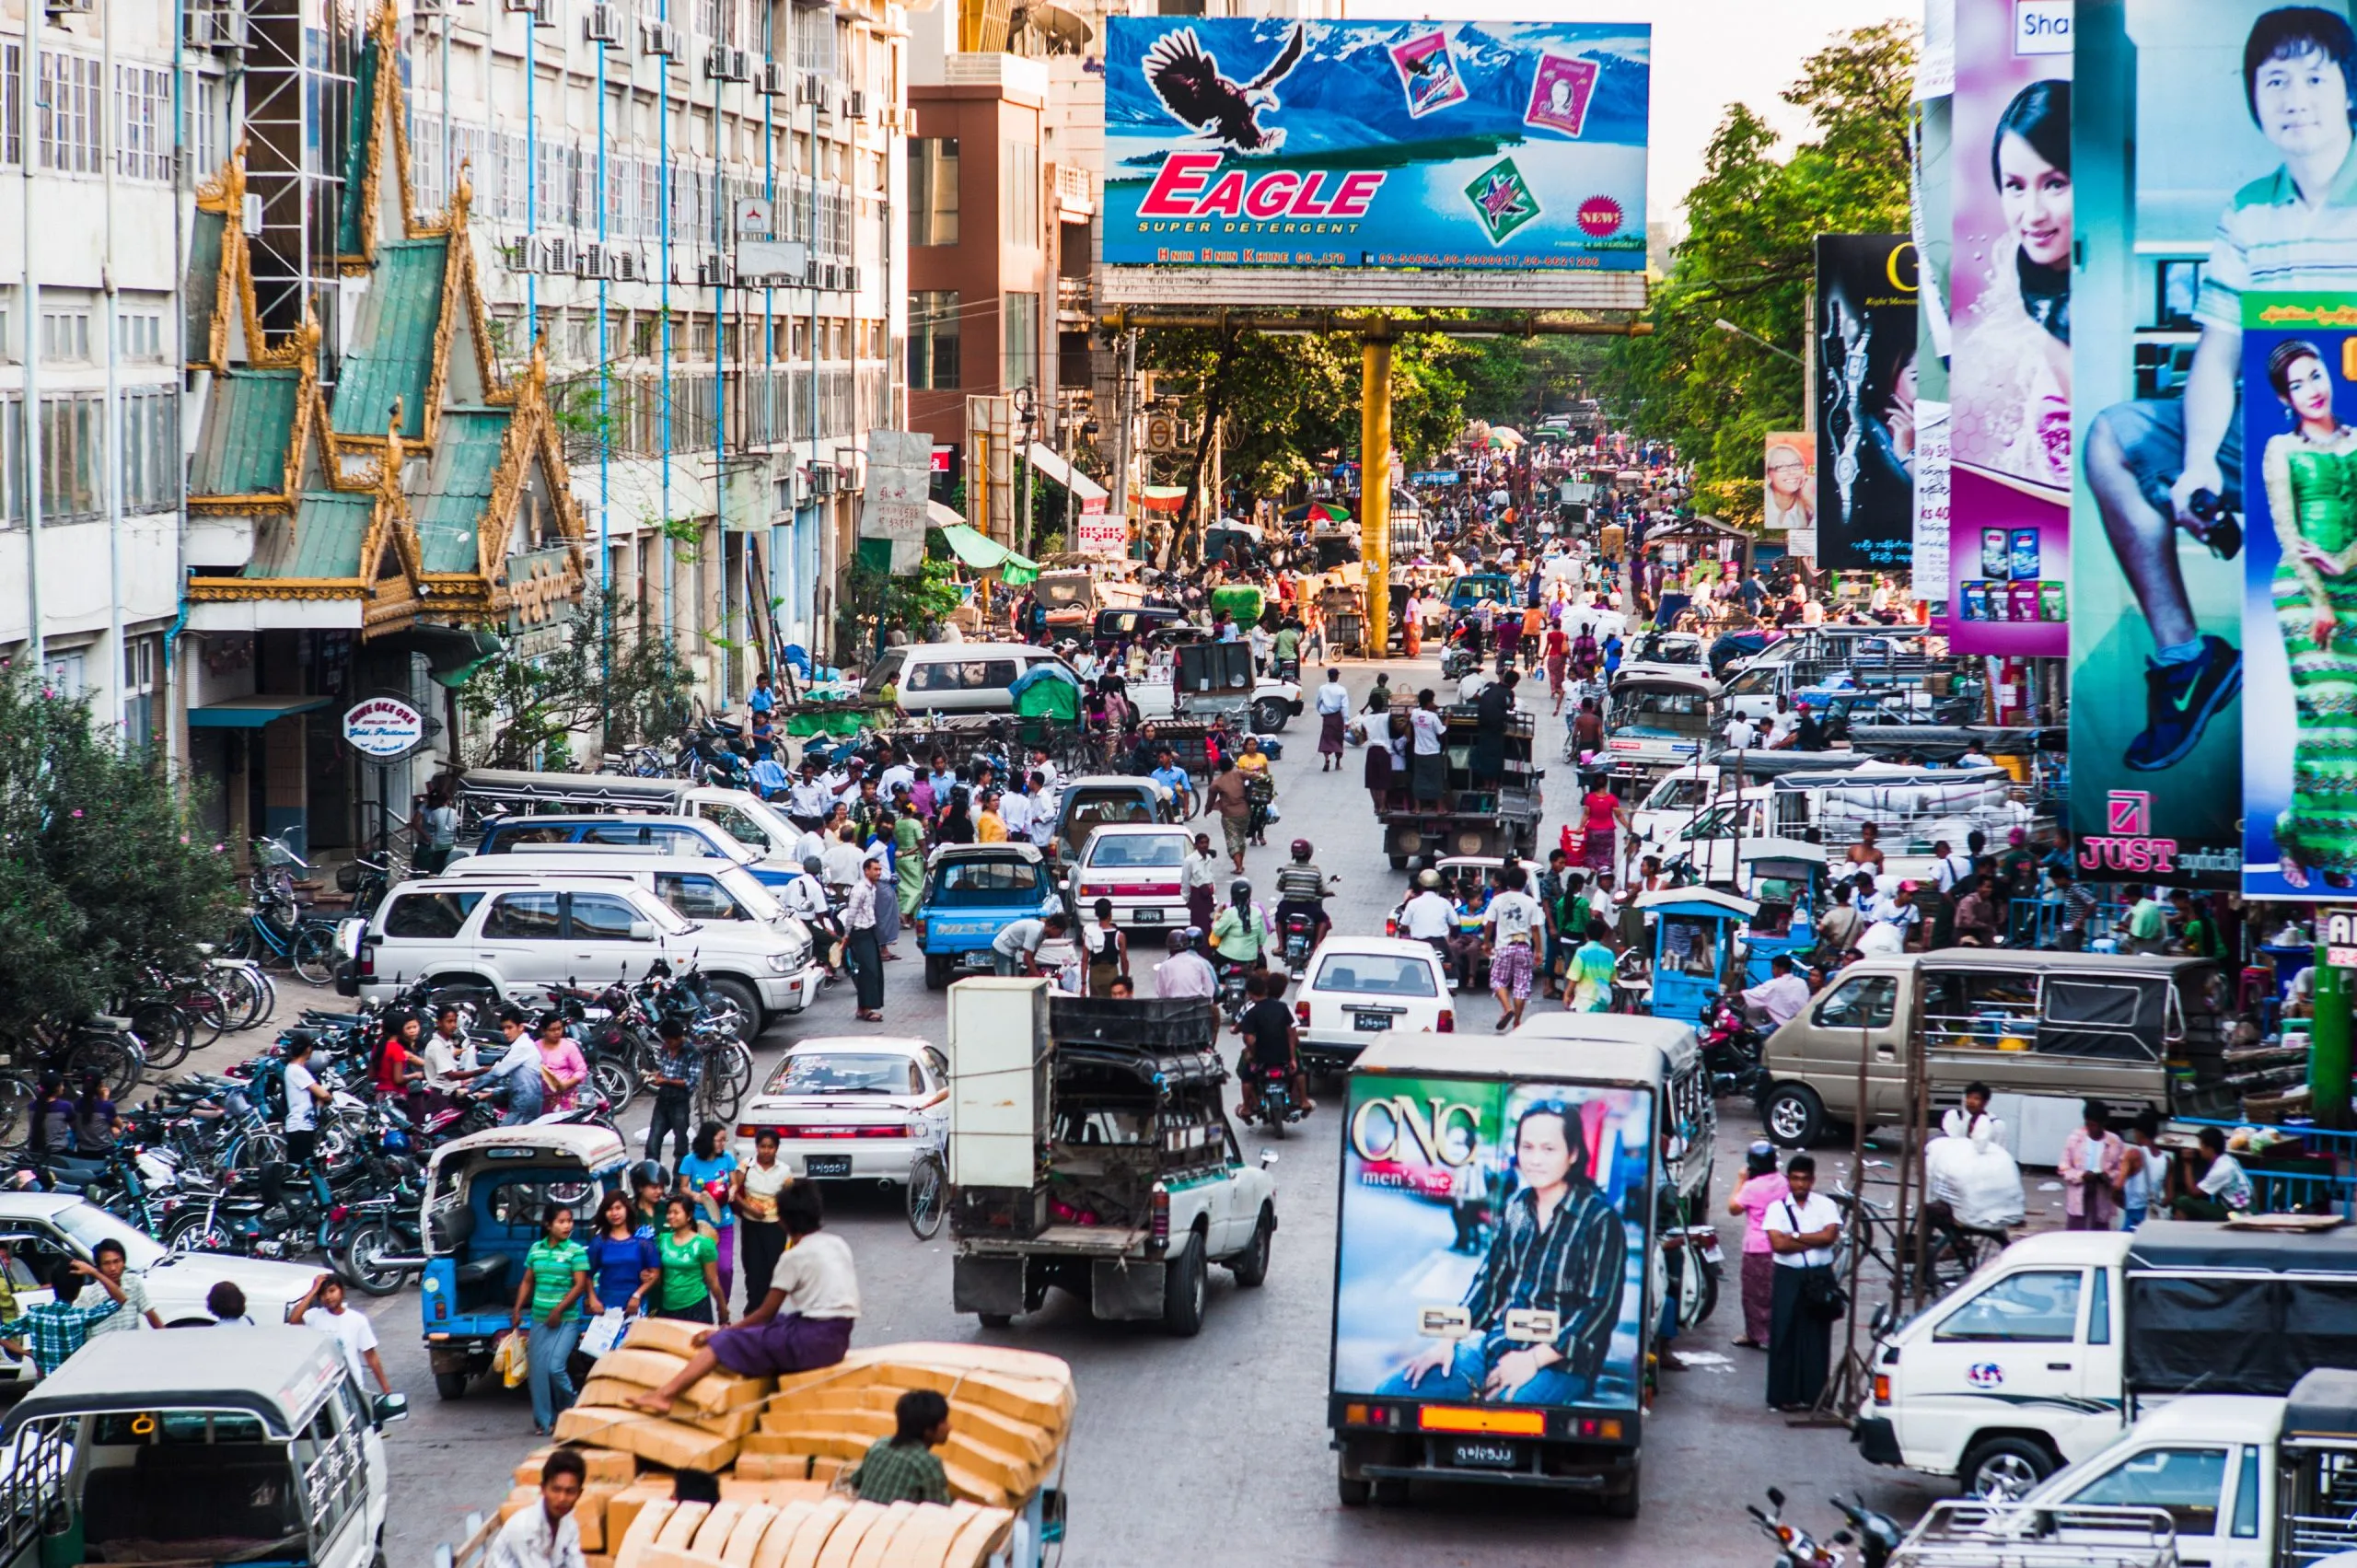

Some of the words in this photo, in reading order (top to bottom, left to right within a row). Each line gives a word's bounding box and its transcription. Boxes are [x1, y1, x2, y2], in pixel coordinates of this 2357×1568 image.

[1137, 151, 1387, 220] EAGLE
[1138, 222, 1212, 233] SUPER
[1225, 222, 1359, 234] DETERGENT
[1581, 212, 1620, 225] NEW!
[2079, 836, 2177, 873] JUST
[1351, 1095, 1481, 1167] CNC
[1363, 1170, 1417, 1188] men's
